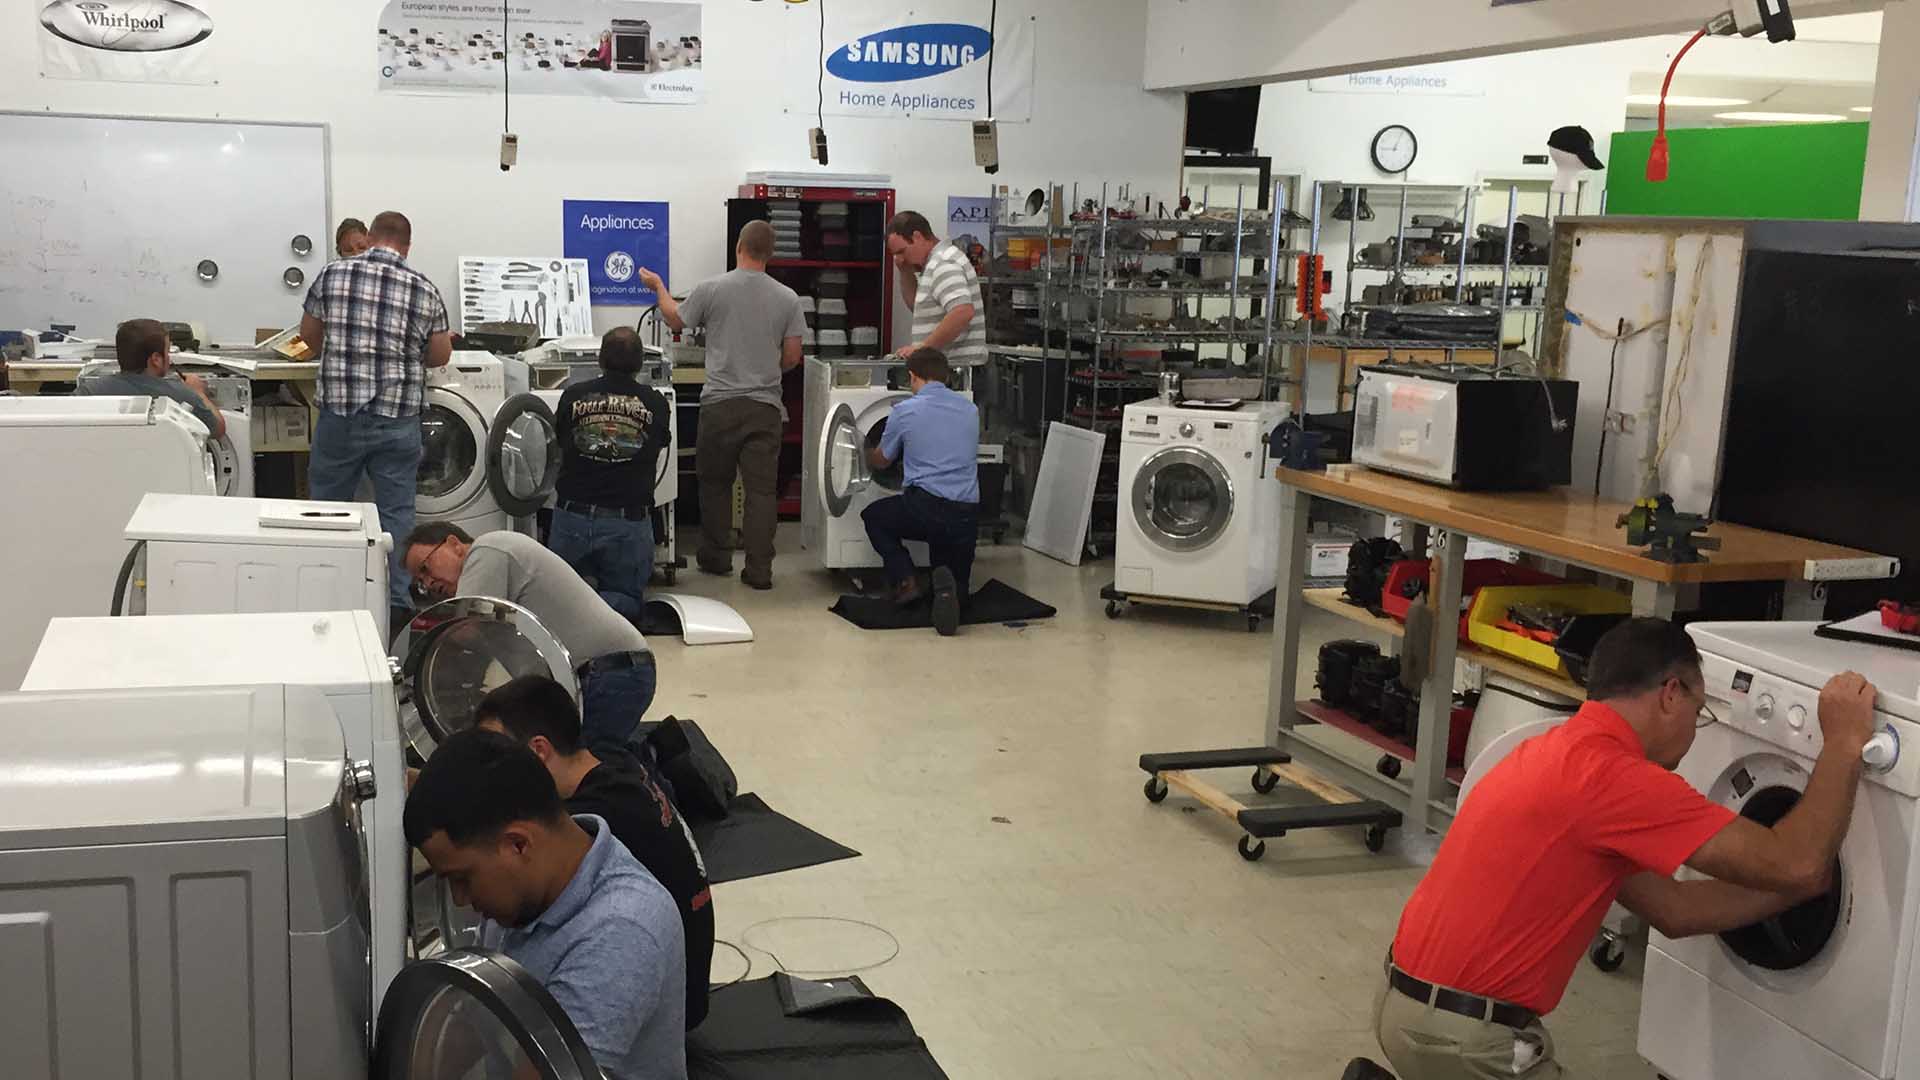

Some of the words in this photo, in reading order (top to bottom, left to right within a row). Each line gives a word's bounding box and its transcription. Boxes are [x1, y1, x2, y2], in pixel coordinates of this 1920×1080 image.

[401, 1, 437, 11] European
[438, 4, 459, 12] styles
[83, 11, 165, 32] Whirlpool
[847, 40, 975, 68] SAMSUNG
[658, 83, 694, 92] Electrolux
[1349, 73, 1382, 86] Home
[1386, 75, 1447, 88] Appliances
[840, 91, 885, 106] Home
[891, 93, 976, 110] Appliances
[580, 214, 655, 232] Appliances
[571, 400, 606, 420] Four
[607, 395, 654, 424] Rivers
